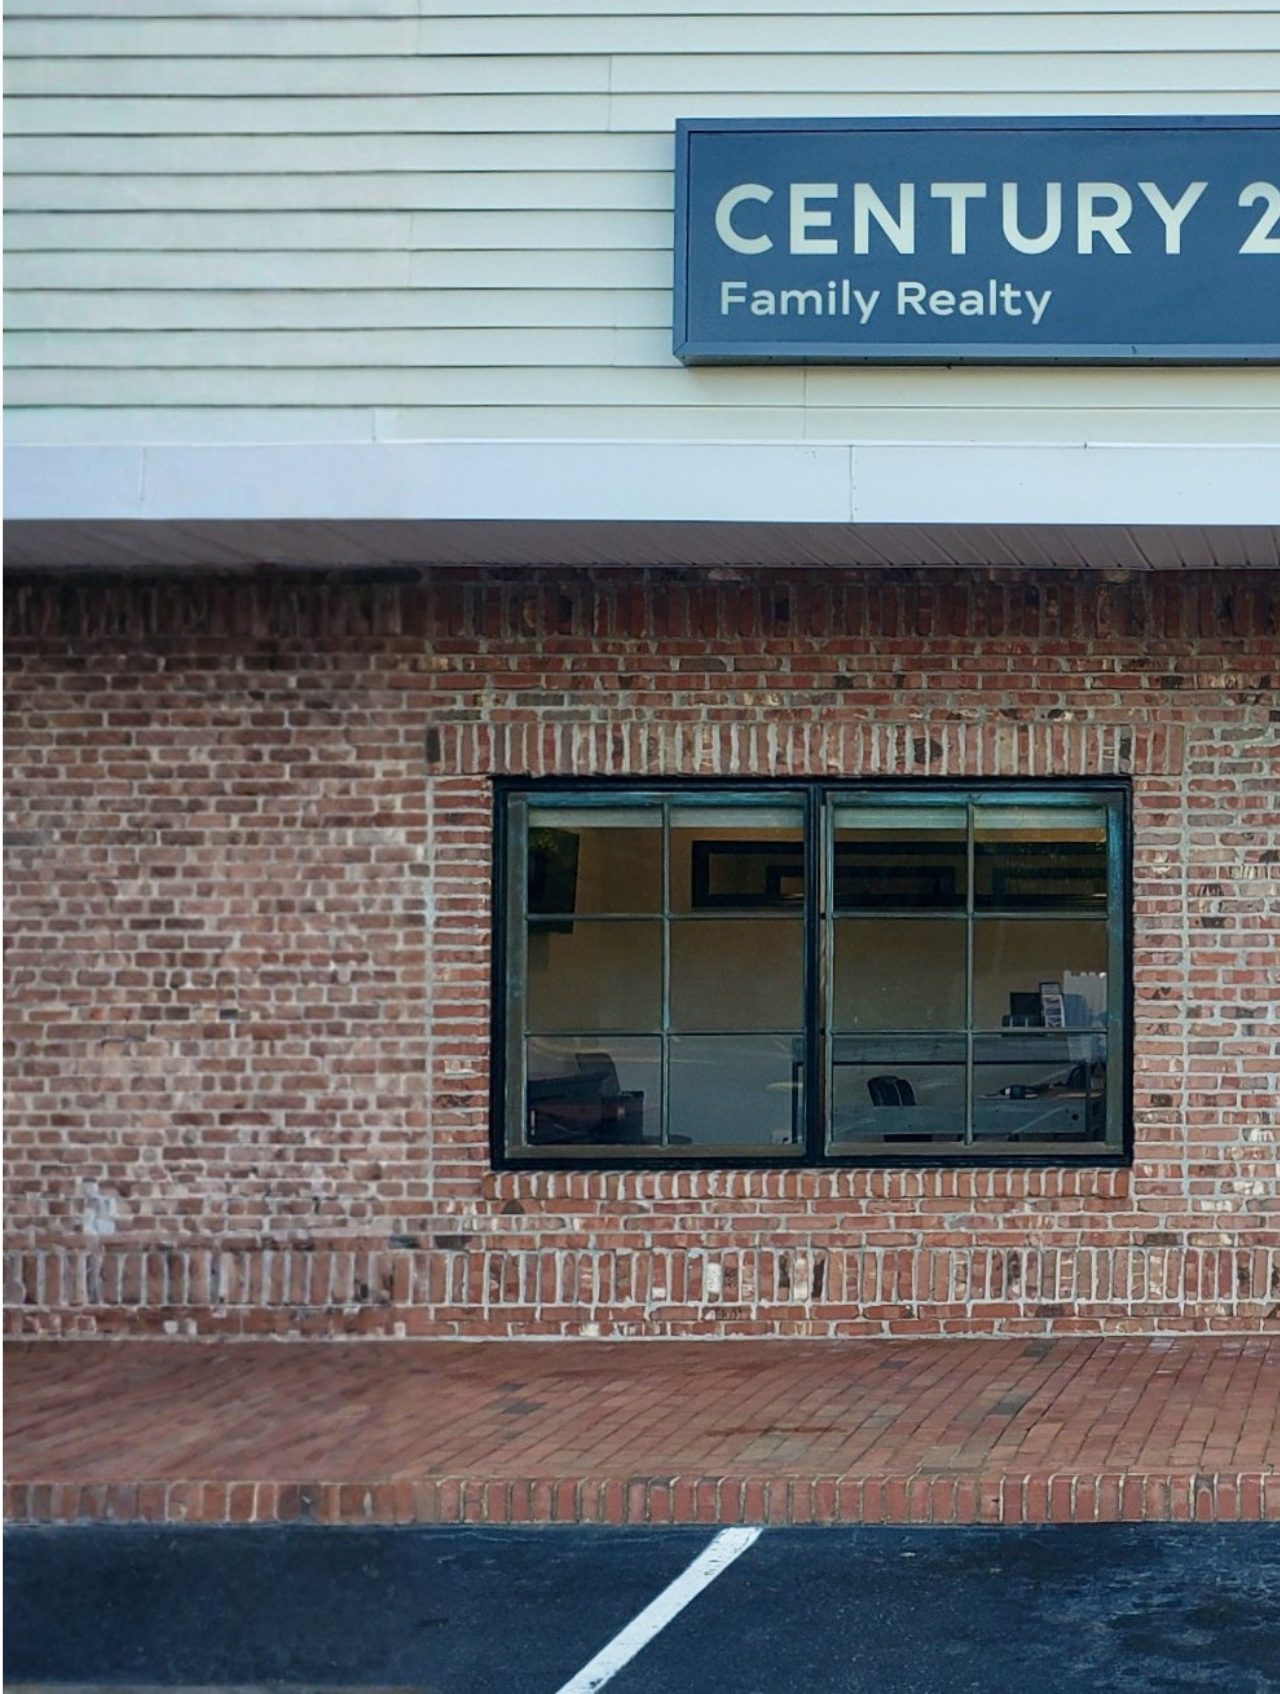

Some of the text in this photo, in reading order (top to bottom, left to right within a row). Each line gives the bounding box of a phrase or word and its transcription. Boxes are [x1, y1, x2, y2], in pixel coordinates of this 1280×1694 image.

[715, 182, 1207, 254] CENTURY
[721, 279, 1052, 324] Family Realty
